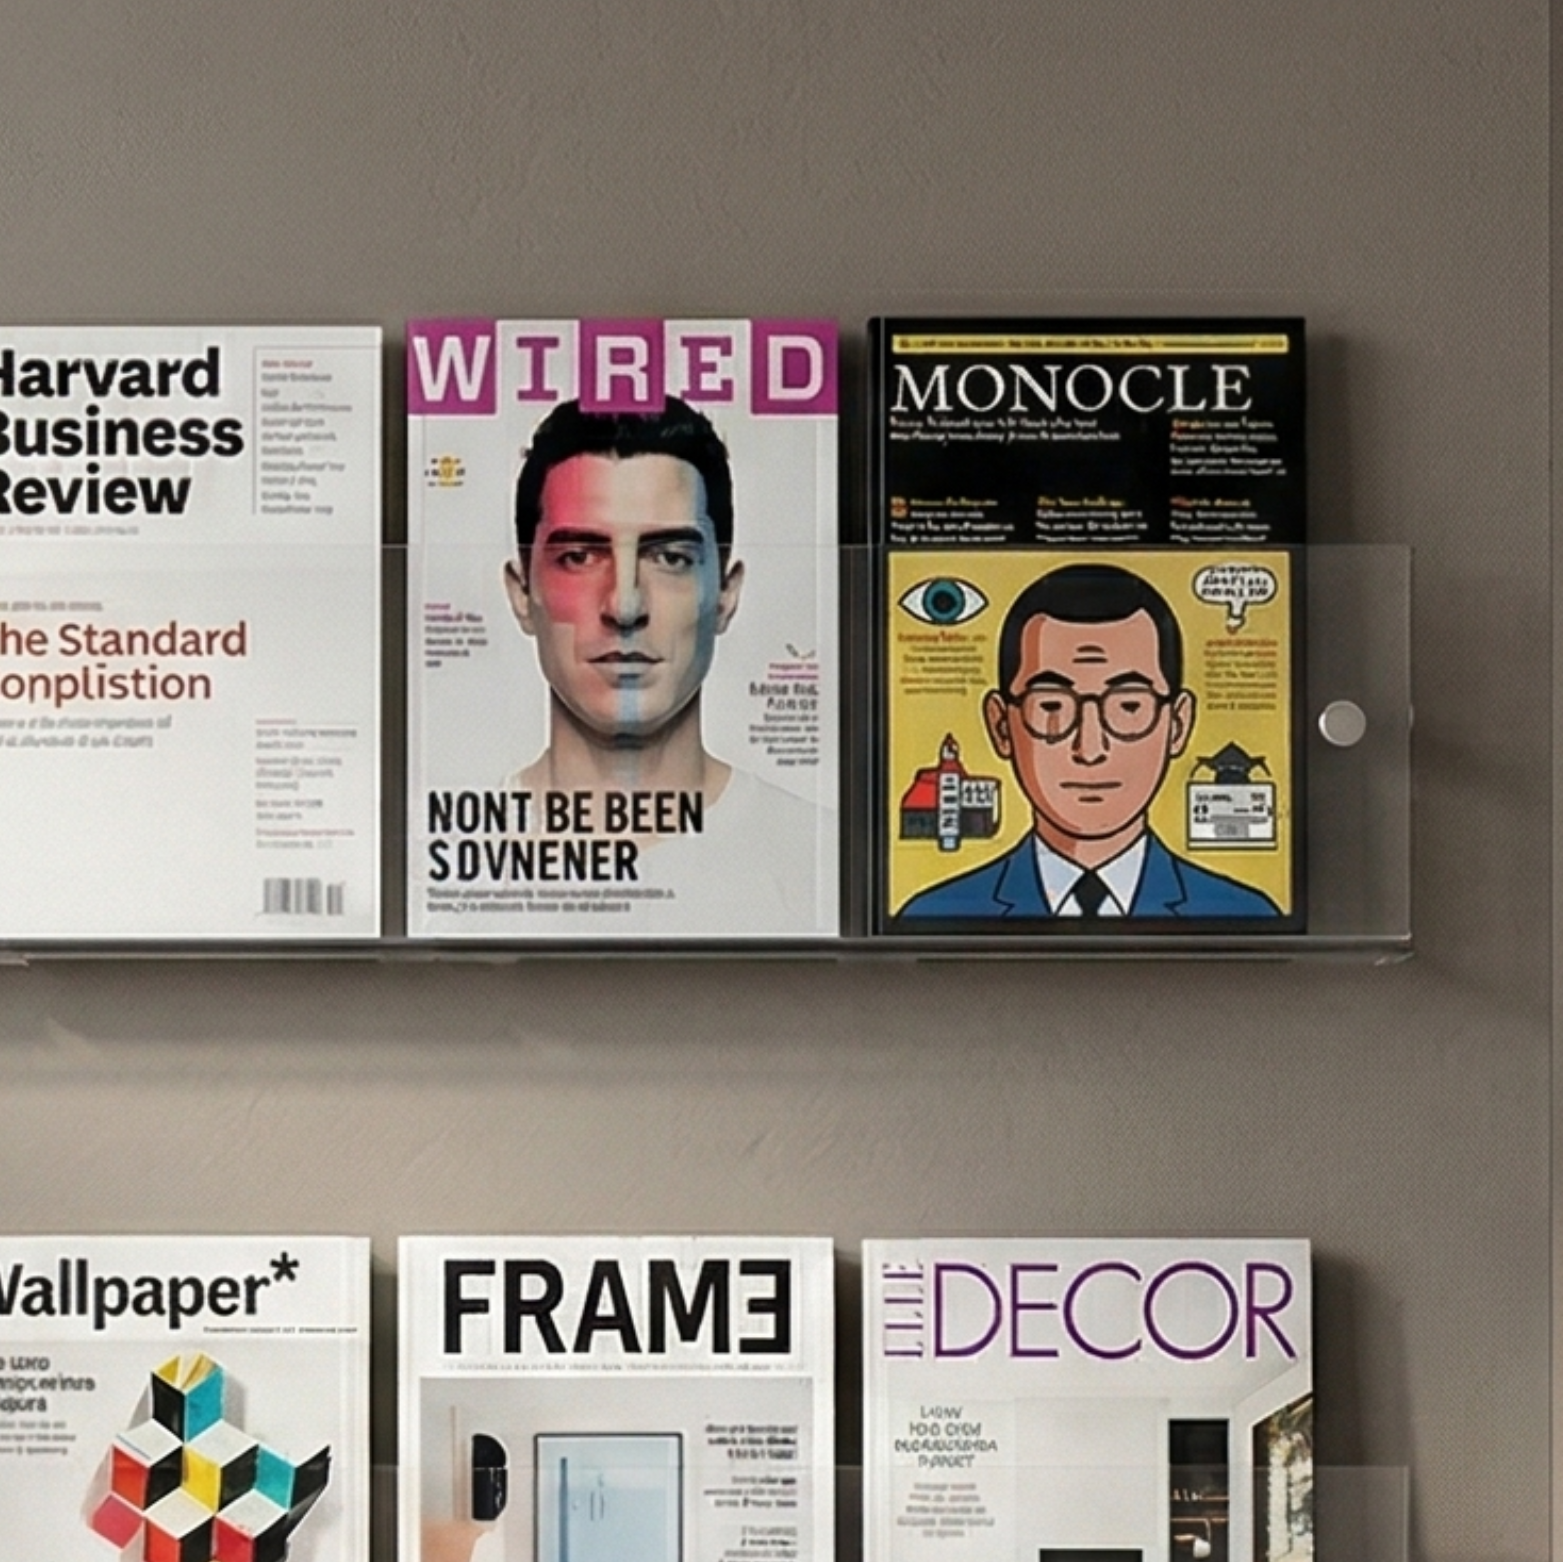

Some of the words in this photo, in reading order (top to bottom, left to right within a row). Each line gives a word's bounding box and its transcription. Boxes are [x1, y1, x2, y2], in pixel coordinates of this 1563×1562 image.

[413, 335, 824, 402] WIRED
[890, 362, 1253, 413] MONOCLE
[59, 620, 248, 657] Standard
[428, 791, 532, 834] NONT
[545, 791, 594, 834] BE
[605, 791, 703, 834] BEEN
[934, 1260, 1297, 1359] DECOR
